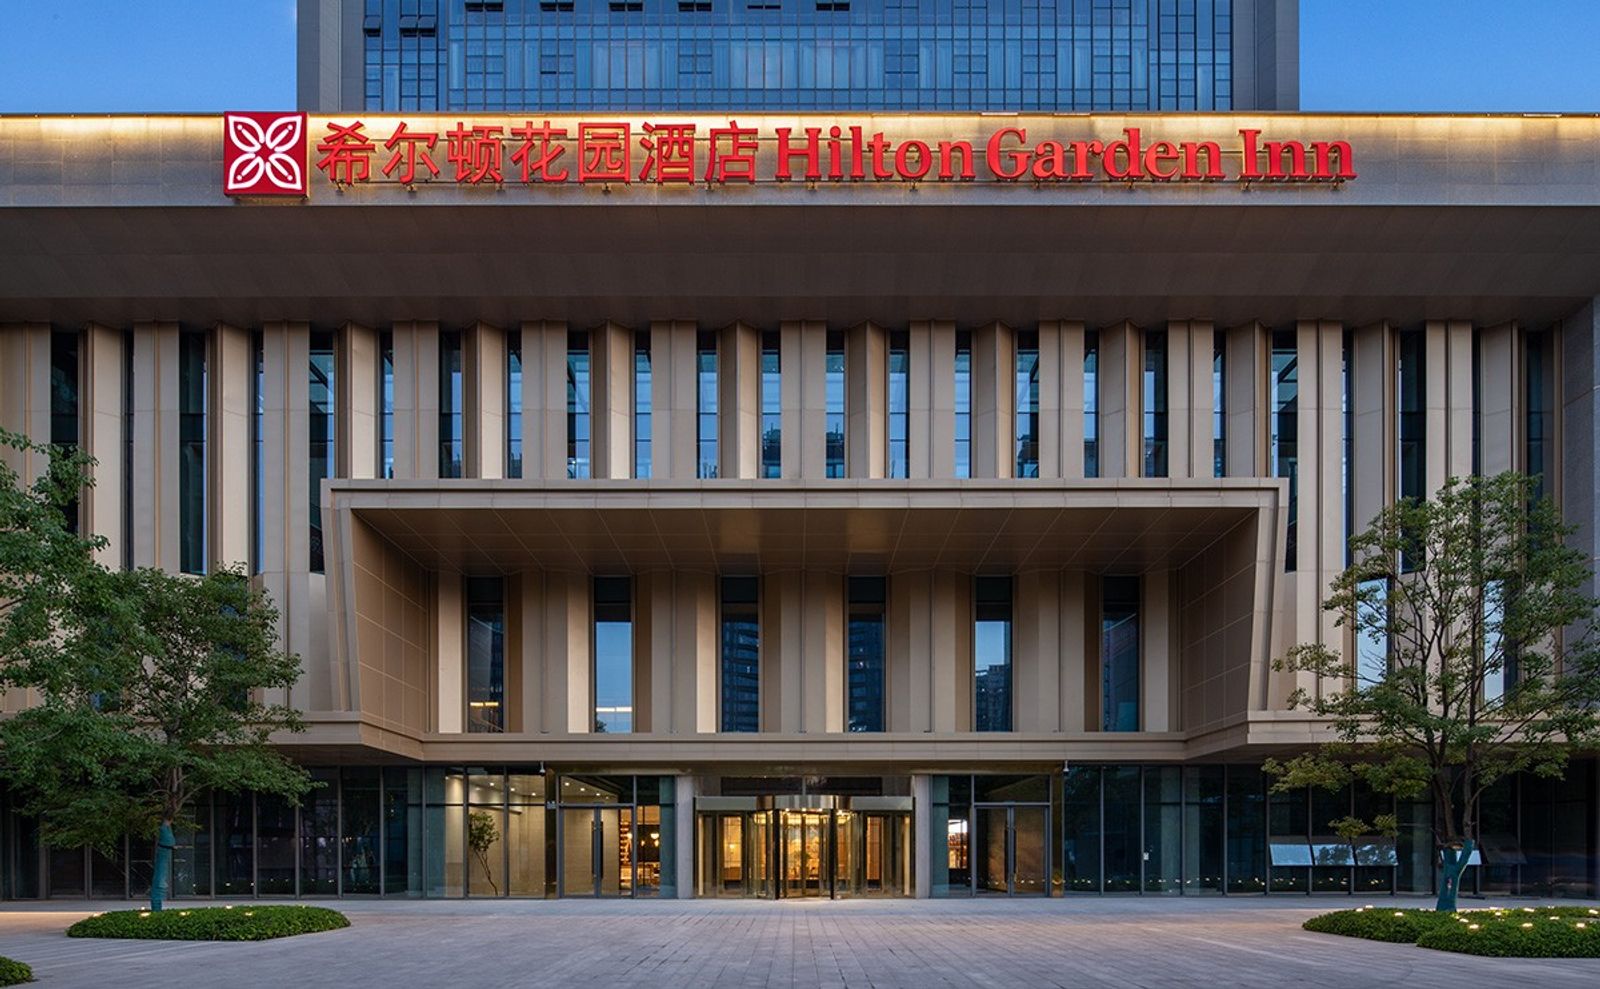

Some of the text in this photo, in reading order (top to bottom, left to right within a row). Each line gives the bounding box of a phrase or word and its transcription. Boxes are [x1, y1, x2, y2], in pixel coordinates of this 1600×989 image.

[316, 119, 759, 184] 希尔顿花园酒店
[775, 125, 1357, 182] Hilton Garden Inn
